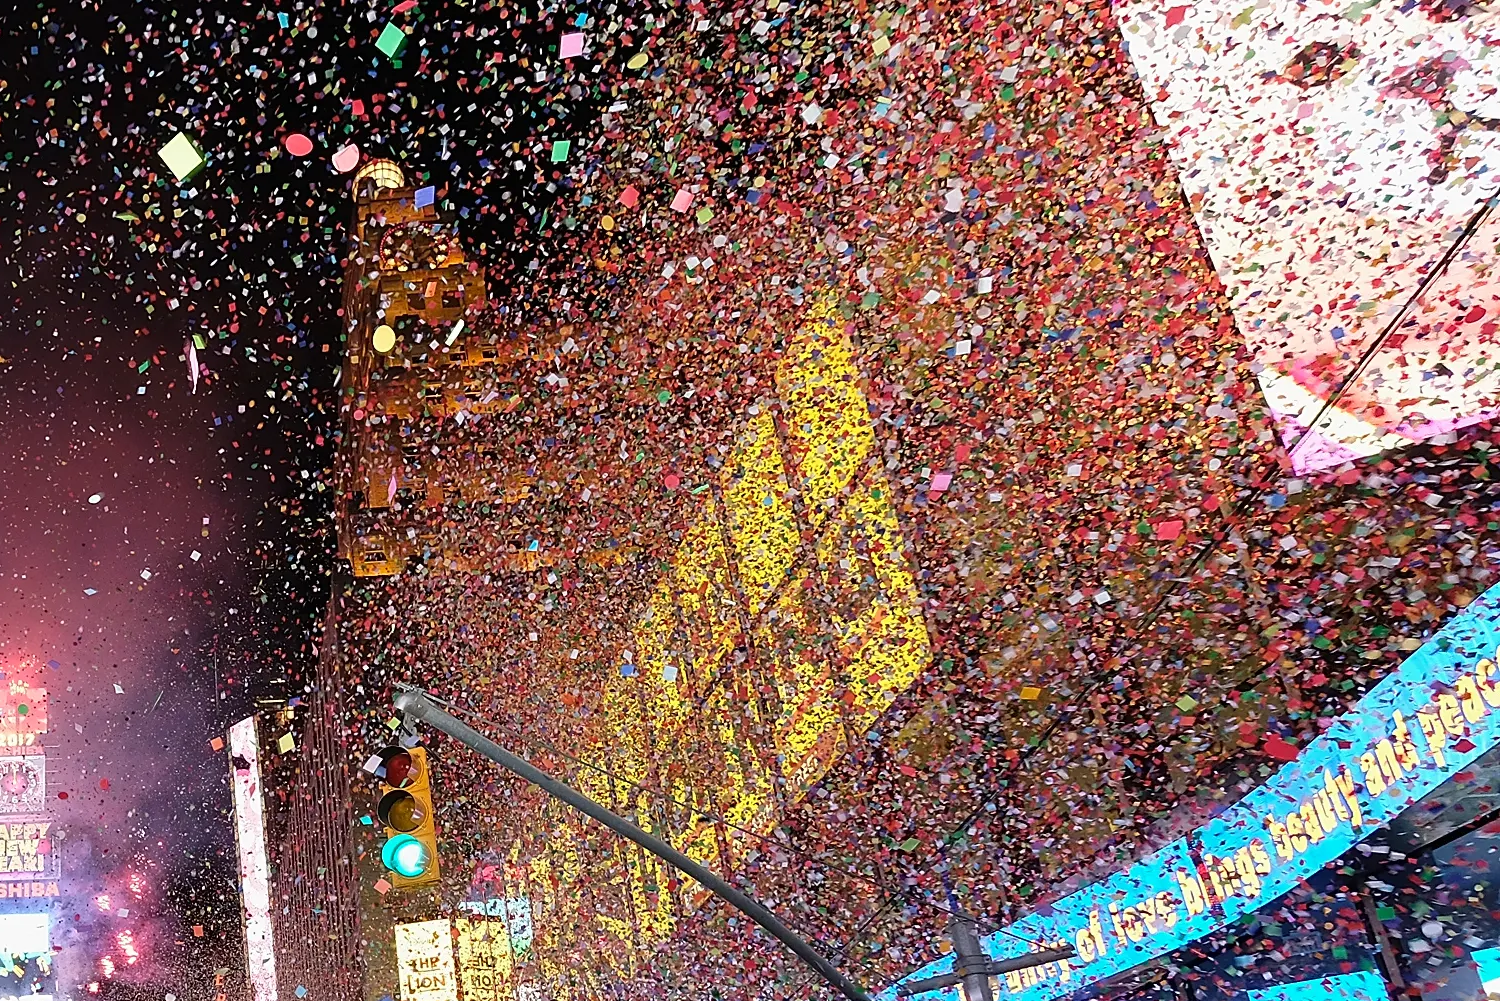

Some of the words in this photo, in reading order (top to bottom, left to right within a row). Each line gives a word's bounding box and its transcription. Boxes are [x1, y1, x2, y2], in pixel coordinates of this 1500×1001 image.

[1075, 911, 1108, 964] of
[1109, 889, 1179, 944] love
[1268, 767, 1364, 861] beauty
[1359, 708, 1420, 797] and
[1420, 655, 1500, 769] peac
[404, 974, 446, 994] LION
